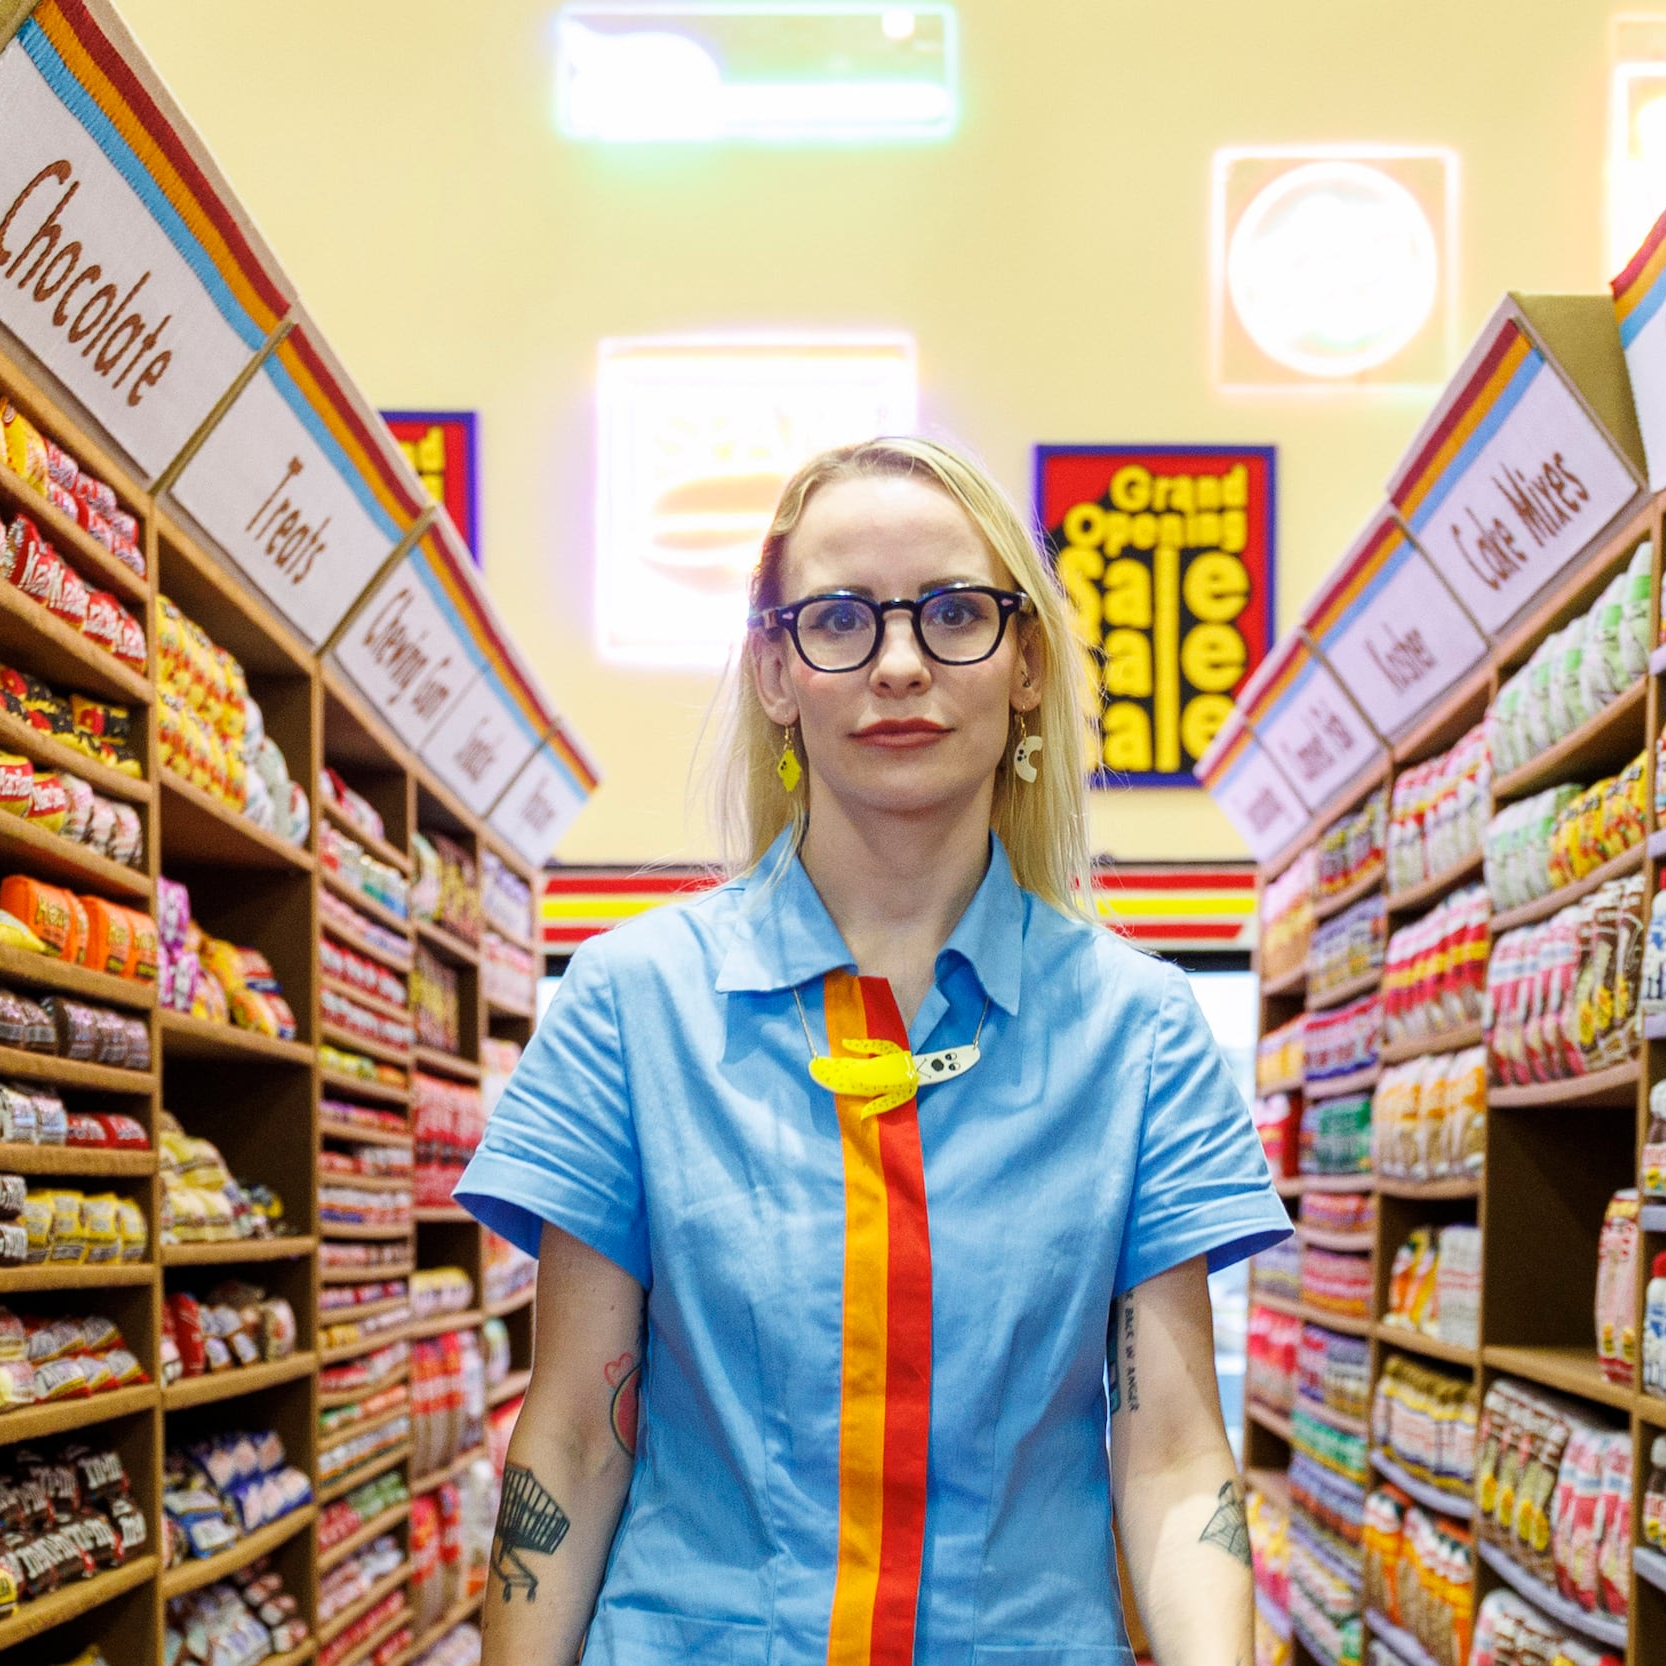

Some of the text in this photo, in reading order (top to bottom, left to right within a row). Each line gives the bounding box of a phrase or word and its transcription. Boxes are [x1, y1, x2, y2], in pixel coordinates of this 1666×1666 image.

[246, 456, 329, 585] Treats
[1110, 464, 1248, 512] Grand
[1451, 451, 1589, 591] Cake Mixes
[1063, 503, 1247, 558] Opening
[1057, 546, 1250, 628] Sale
[1085, 695, 1237, 773] ale
